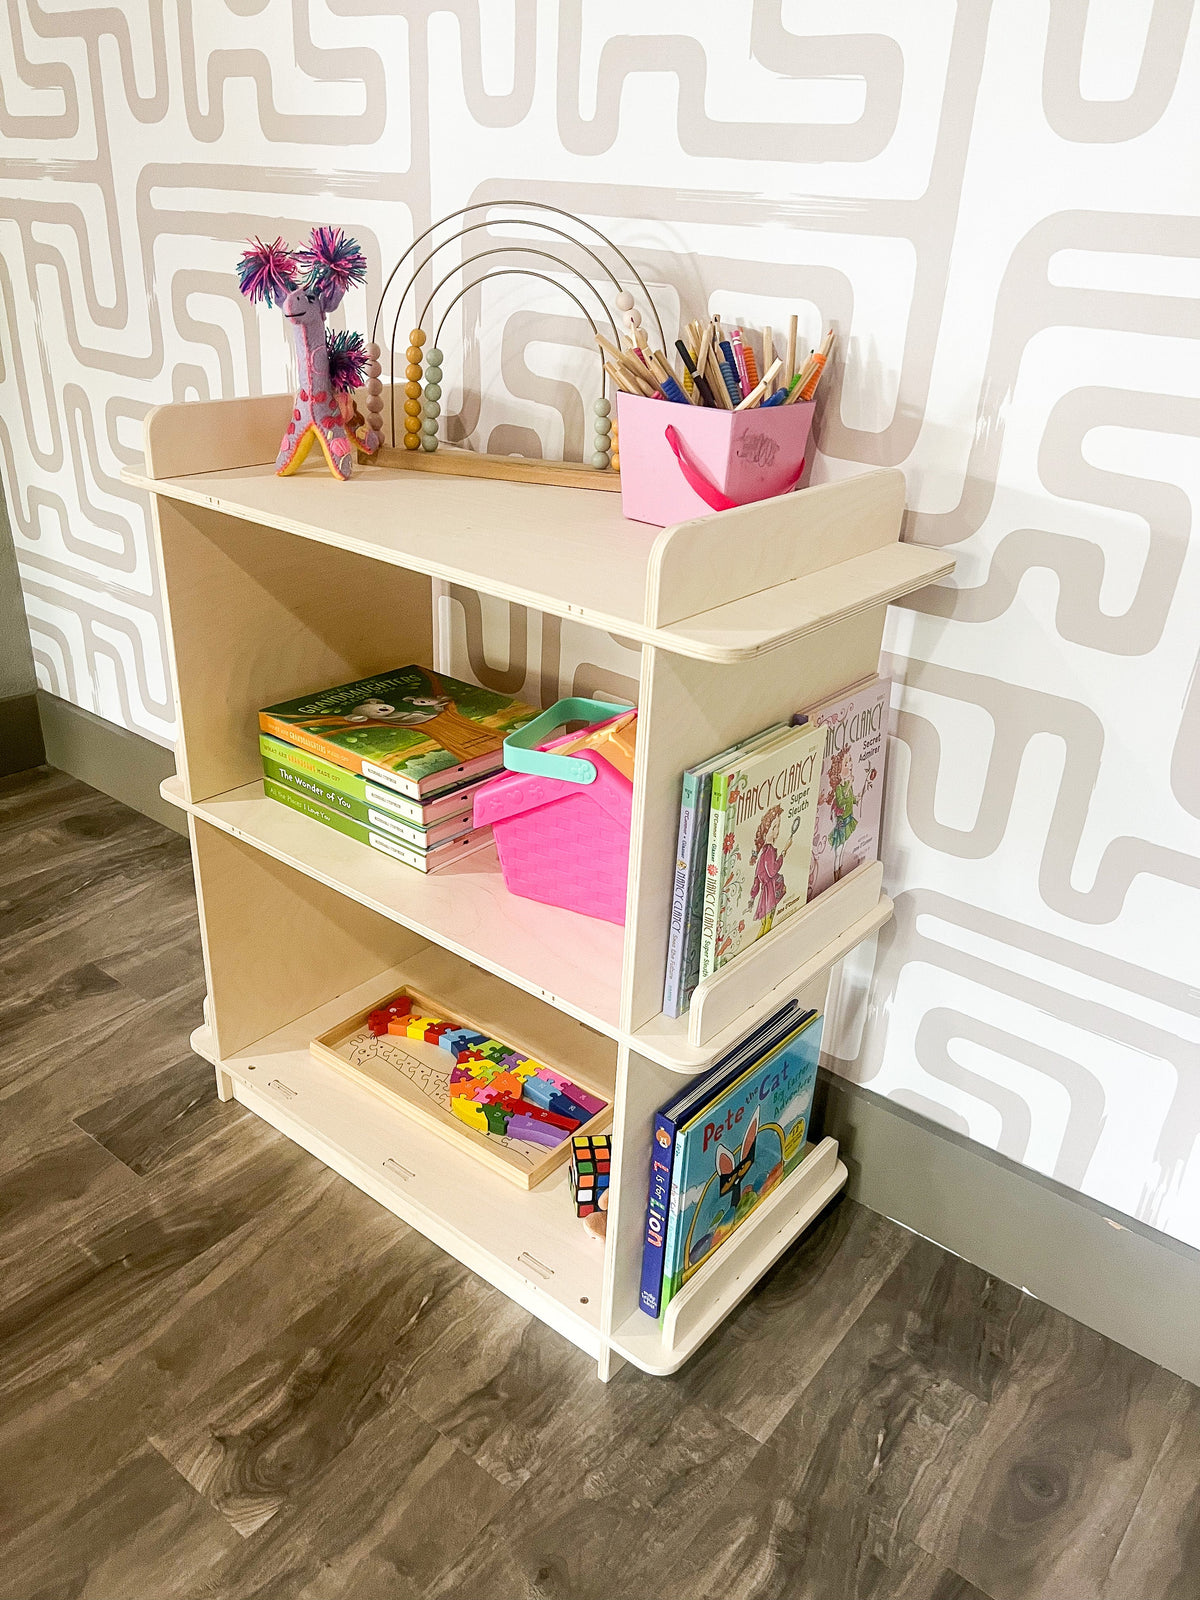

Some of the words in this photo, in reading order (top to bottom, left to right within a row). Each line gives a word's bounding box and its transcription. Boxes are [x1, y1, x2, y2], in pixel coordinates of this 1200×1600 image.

[298, 674, 421, 714] GRANDDAUGHTERS
[823, 720, 848, 759] ANCY
[850, 701, 884, 743] CLANCY
[863, 732, 881, 750] Secret
[858, 746, 880, 763] Admirer
[279, 768, 293, 782] The
[295, 776, 324, 796] Wonder
[326, 792, 335, 802] of
[337, 796, 351, 809] You
[736, 776, 775, 826] NANCY
[775, 752, 817, 800] CLANCY
[790, 787, 810, 805] Super
[307, 805, 320, 817] Love
[321, 812, 331, 821] You
[788, 800, 809, 818] Sleuth
[674, 871, 686, 901] NANCY
[705, 877, 717, 907] NANCY
[672, 900, 683, 933] CLANCY
[703, 905, 715, 940] CLANCY
[703, 940, 711, 957] Super
[702, 957, 710, 978] Sleuth
[703, 1106, 745, 1153] Pete
[745, 1087, 759, 1104] the
[759, 1061, 790, 1101] Cat
[773, 1089, 785, 1104] Big
[653, 1161, 669, 1173] L
[655, 1174, 665, 1183] is
[655, 1184, 666, 1200] for
[647, 1197, 666, 1247] Lion
